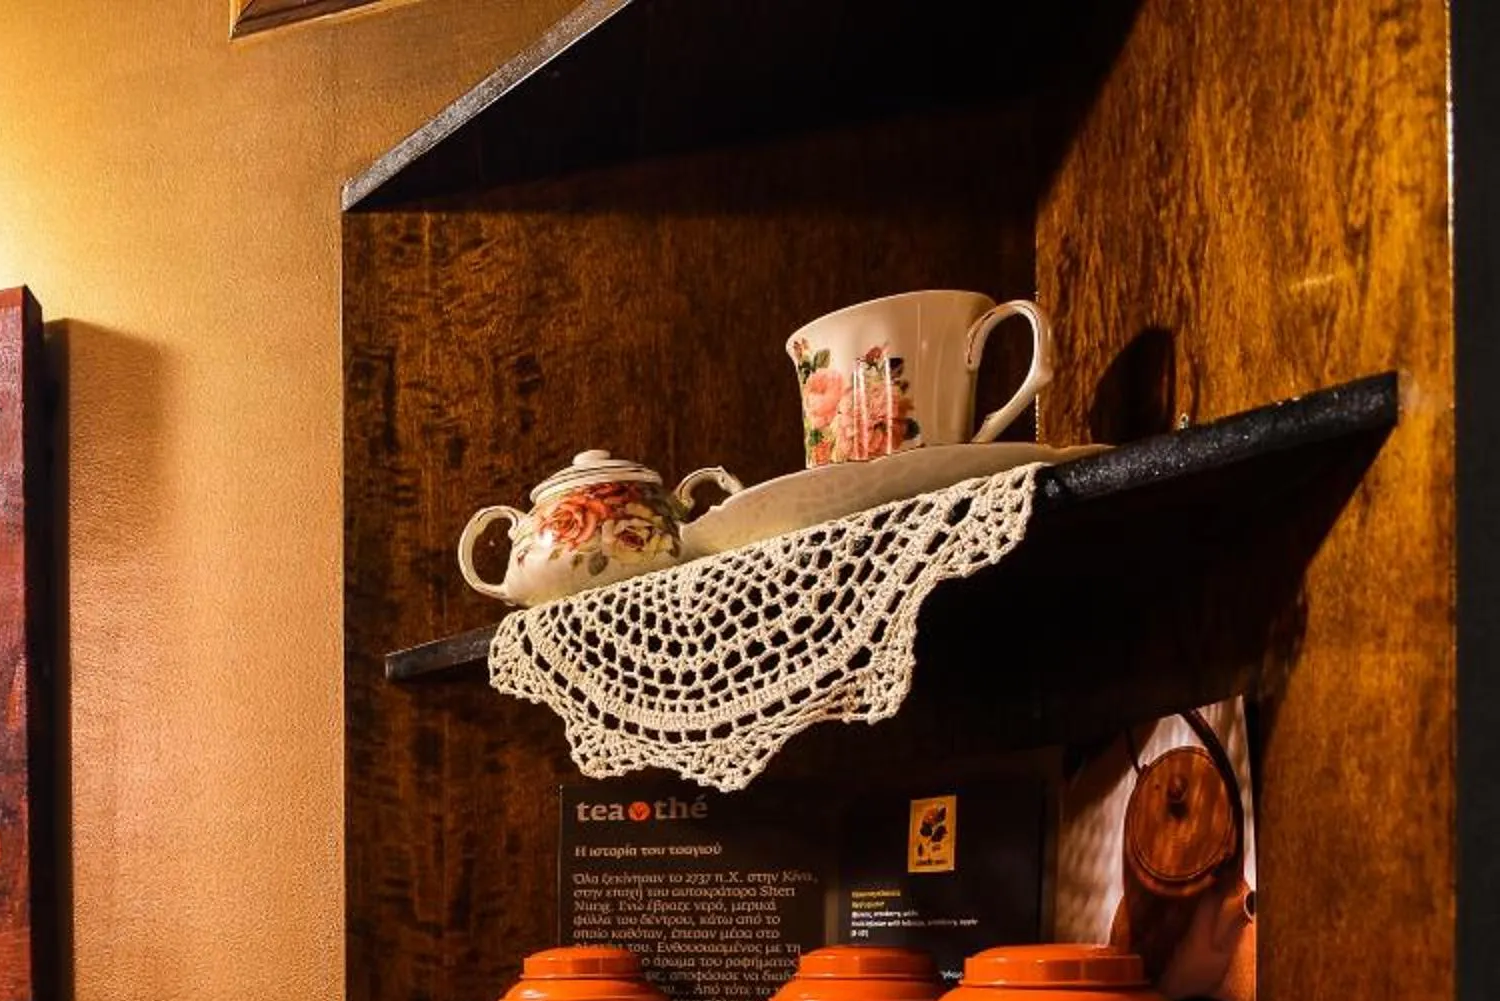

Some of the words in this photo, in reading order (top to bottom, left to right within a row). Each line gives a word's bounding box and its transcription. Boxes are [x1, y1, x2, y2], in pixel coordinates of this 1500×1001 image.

[576, 801, 624, 821] tea
[653, 794, 708, 819] thé
[575, 845, 587, 856] Η
[589, 842, 637, 859] ιστορία
[640, 846, 665, 856] του
[685, 873, 710, 884] 2737
[747, 873, 779, 884] στην
[759, 885, 796, 897] Shen
[617, 915, 638, 925] του
[735, 911, 762, 925] από
[766, 915, 781, 925] το
[700, 957, 723, 967] του
